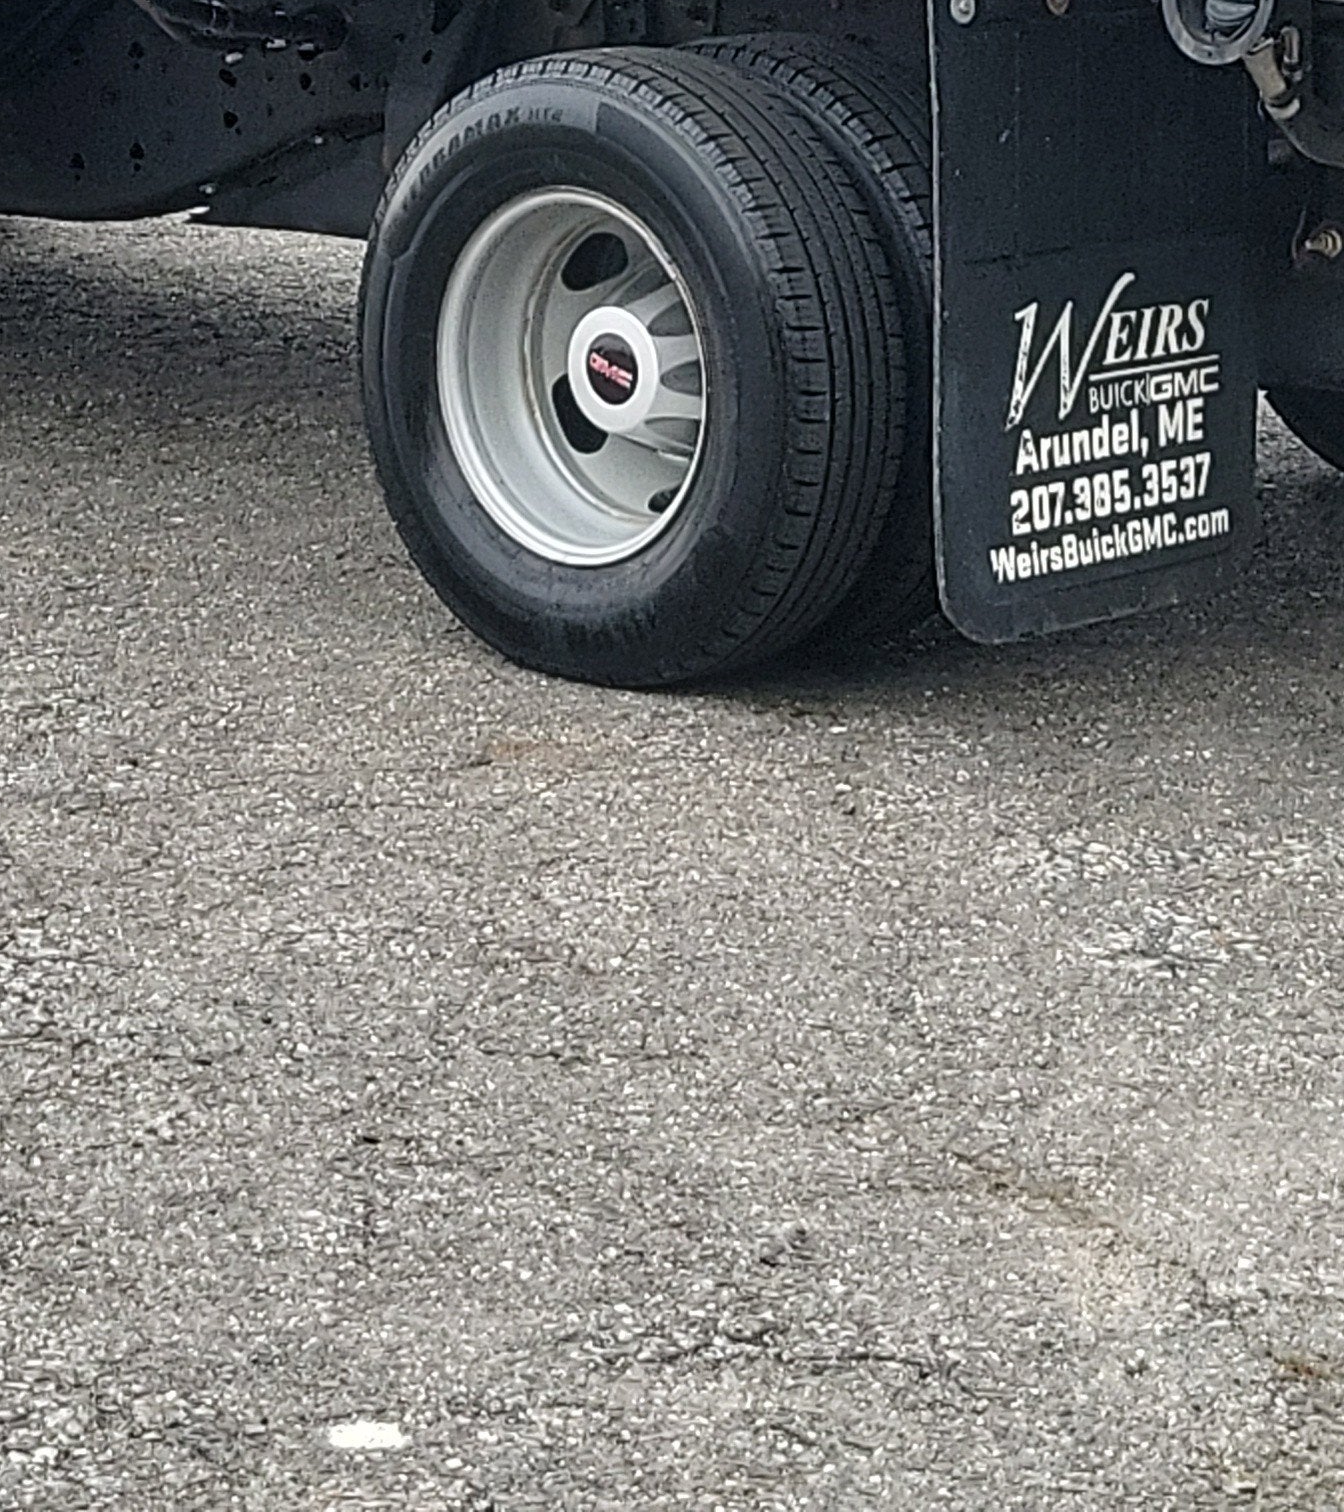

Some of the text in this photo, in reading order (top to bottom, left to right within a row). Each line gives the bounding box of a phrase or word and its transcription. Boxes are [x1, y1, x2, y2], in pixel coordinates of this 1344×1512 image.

[589, 351, 633, 389] GMC
[1005, 272, 1210, 432] WEIRS
[1015, 397, 1205, 476] Arundel, ME
[989, 507, 1230, 584] WeirsBuickGMC.com
